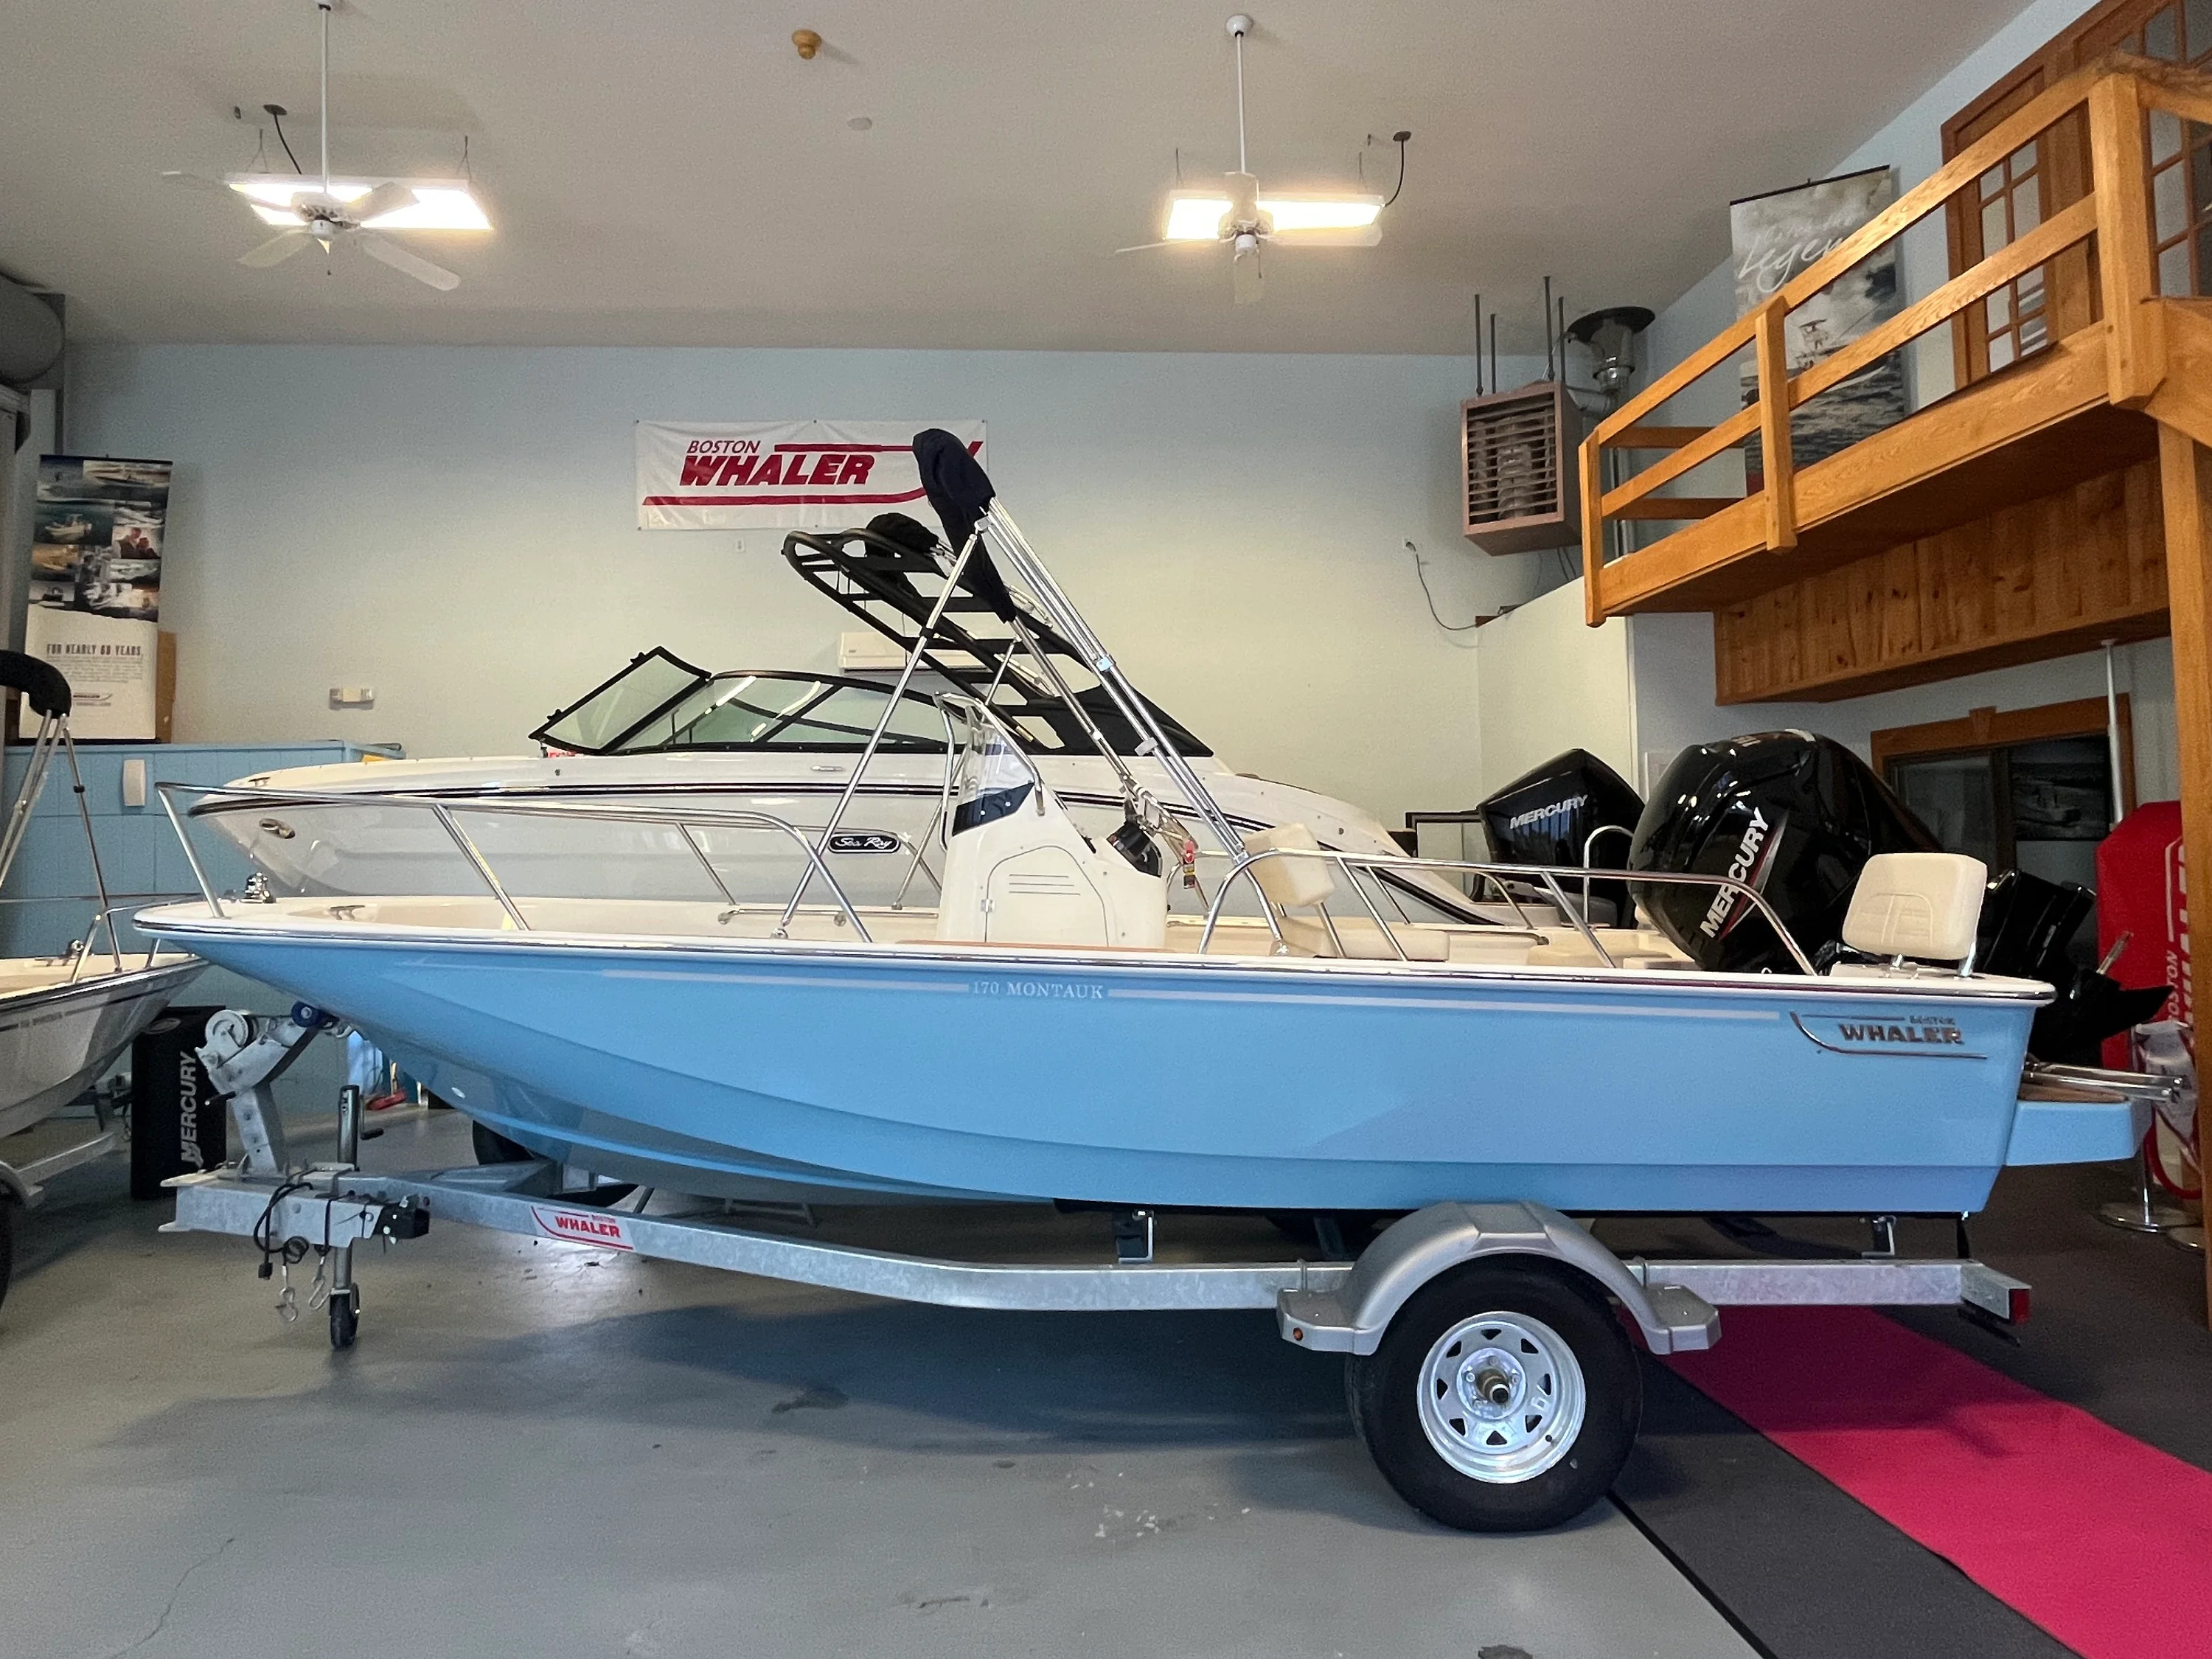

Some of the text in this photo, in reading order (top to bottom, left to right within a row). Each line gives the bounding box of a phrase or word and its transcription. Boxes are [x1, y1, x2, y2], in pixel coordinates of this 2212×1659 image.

[686, 440, 761, 454] BOSTON
[679, 454, 875, 487] WHALER
[65, 644, 97, 655] NEARLY
[1509, 794, 1589, 830] MERCURY
[835, 837, 893, 849] Sea Ray
[1700, 807, 1769, 938] MERCURY
[973, 981, 1105, 999] 170 MONTAUK
[1838, 1023, 1965, 1045] WHALER
[180, 1051, 204, 1168] MERCURY
[554, 1215, 621, 1239] WHALER
